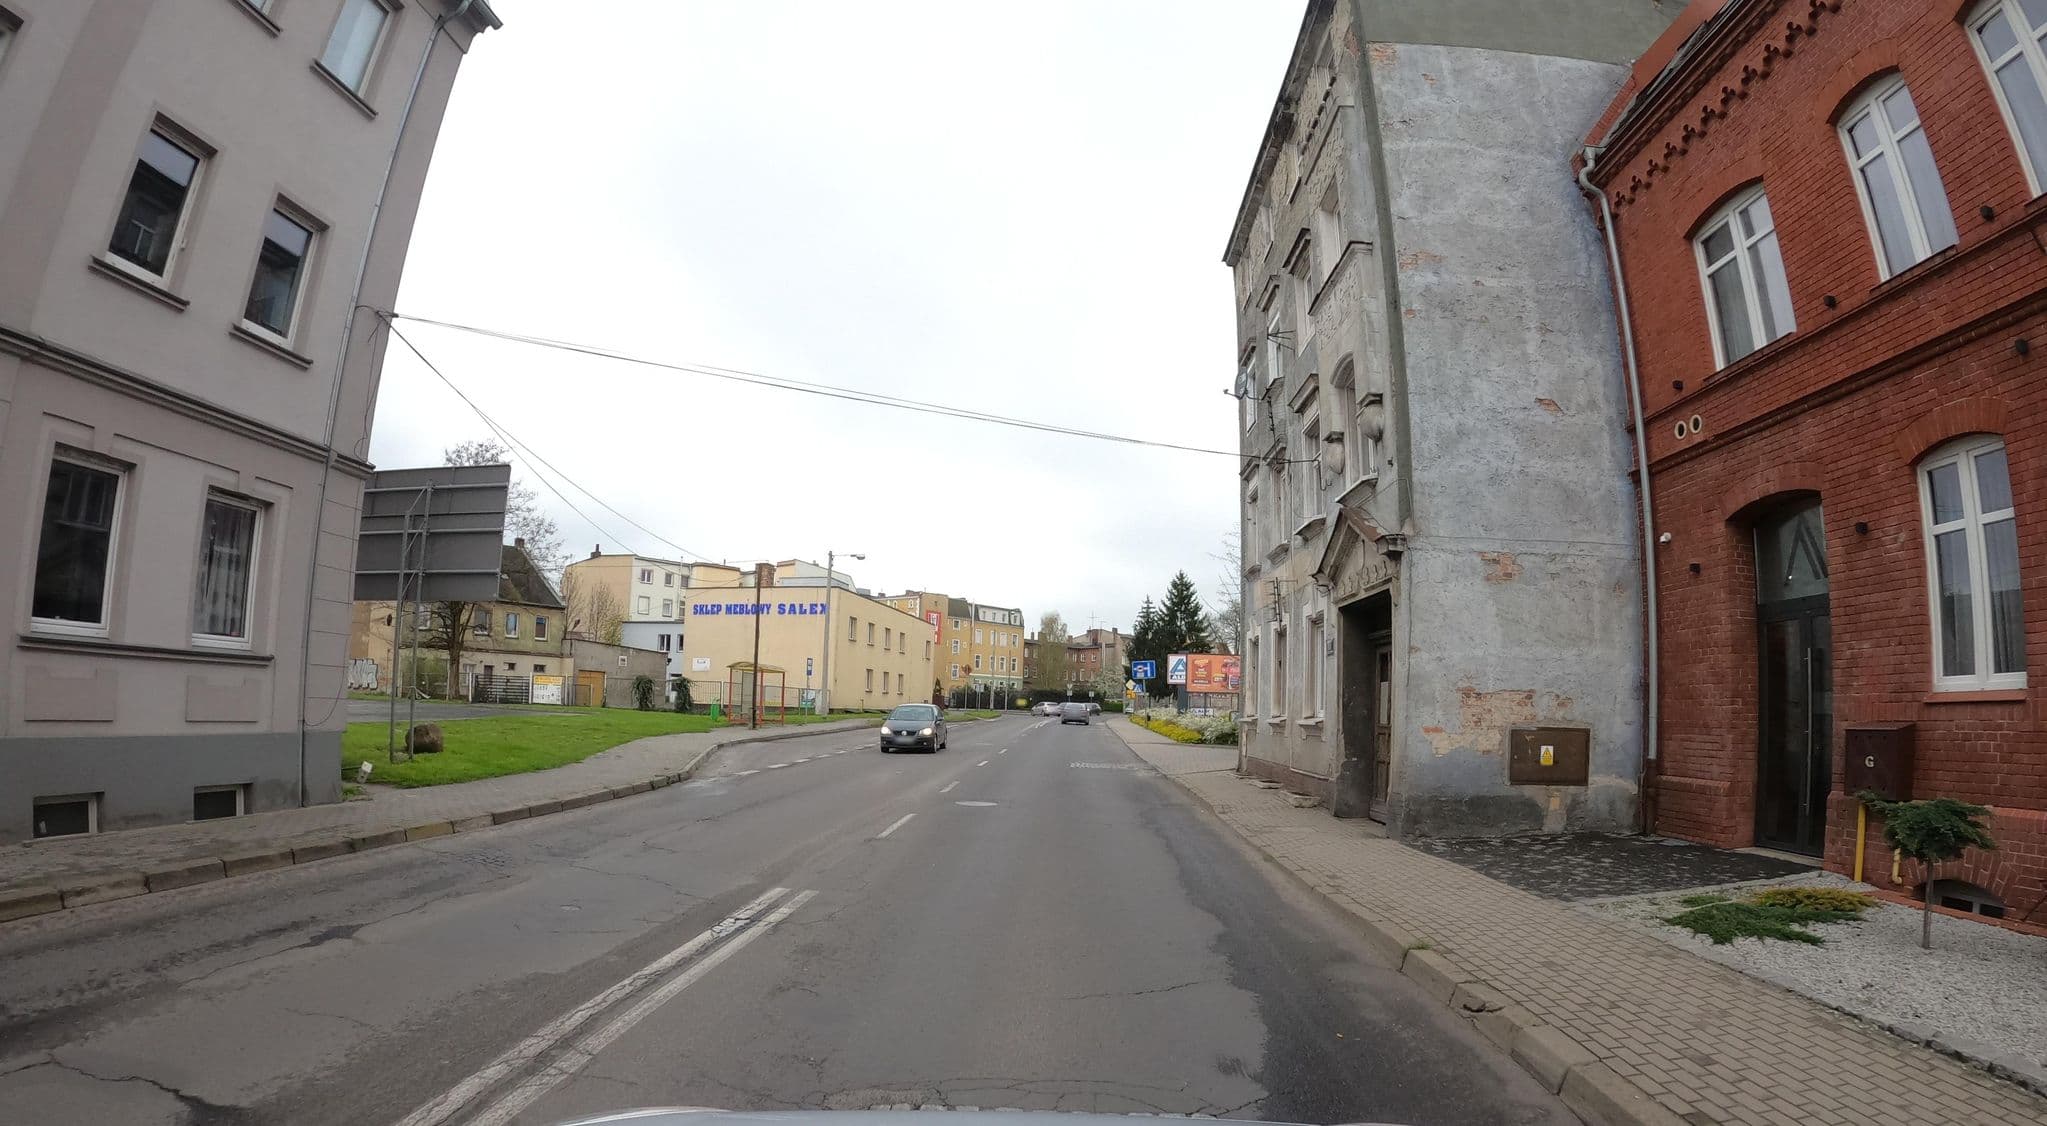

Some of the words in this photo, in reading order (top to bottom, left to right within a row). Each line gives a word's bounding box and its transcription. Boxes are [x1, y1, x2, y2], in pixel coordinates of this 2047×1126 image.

[693, 604, 722, 615] SKLEP
[725, 603, 771, 615] MEBLOWY
[777, 603, 828, 615] SALEX
[1865, 755, 1874, 768] G
